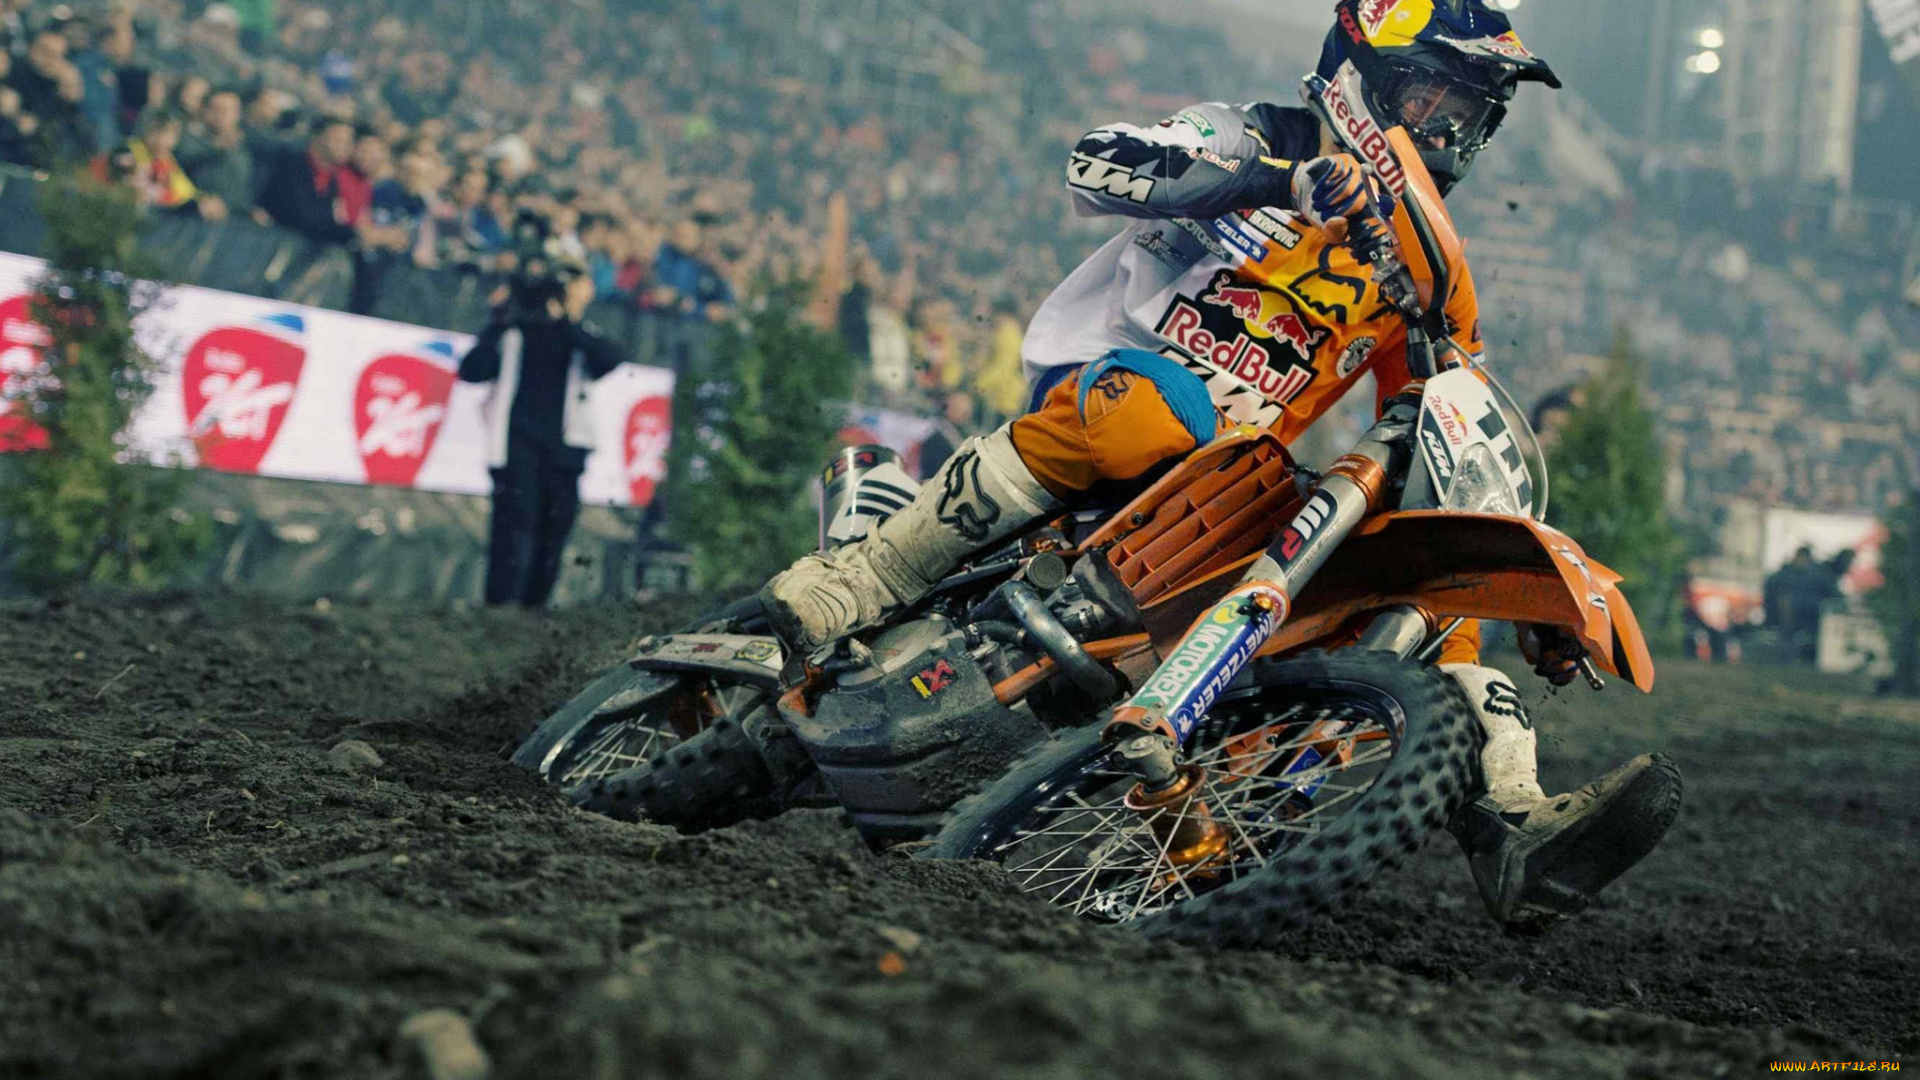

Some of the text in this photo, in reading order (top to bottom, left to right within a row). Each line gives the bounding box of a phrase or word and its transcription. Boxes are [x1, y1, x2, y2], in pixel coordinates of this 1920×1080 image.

[1324, 79, 1407, 199] Red Bull
[1067, 154, 1156, 204] KTM
[1162, 303, 1311, 402] Red Bull
[1422, 429, 1453, 478] KTM
[1428, 395, 1463, 446] Red Bull
[1144, 624, 1230, 699] MOTOREX
[1191, 616, 1271, 720] METZELER
